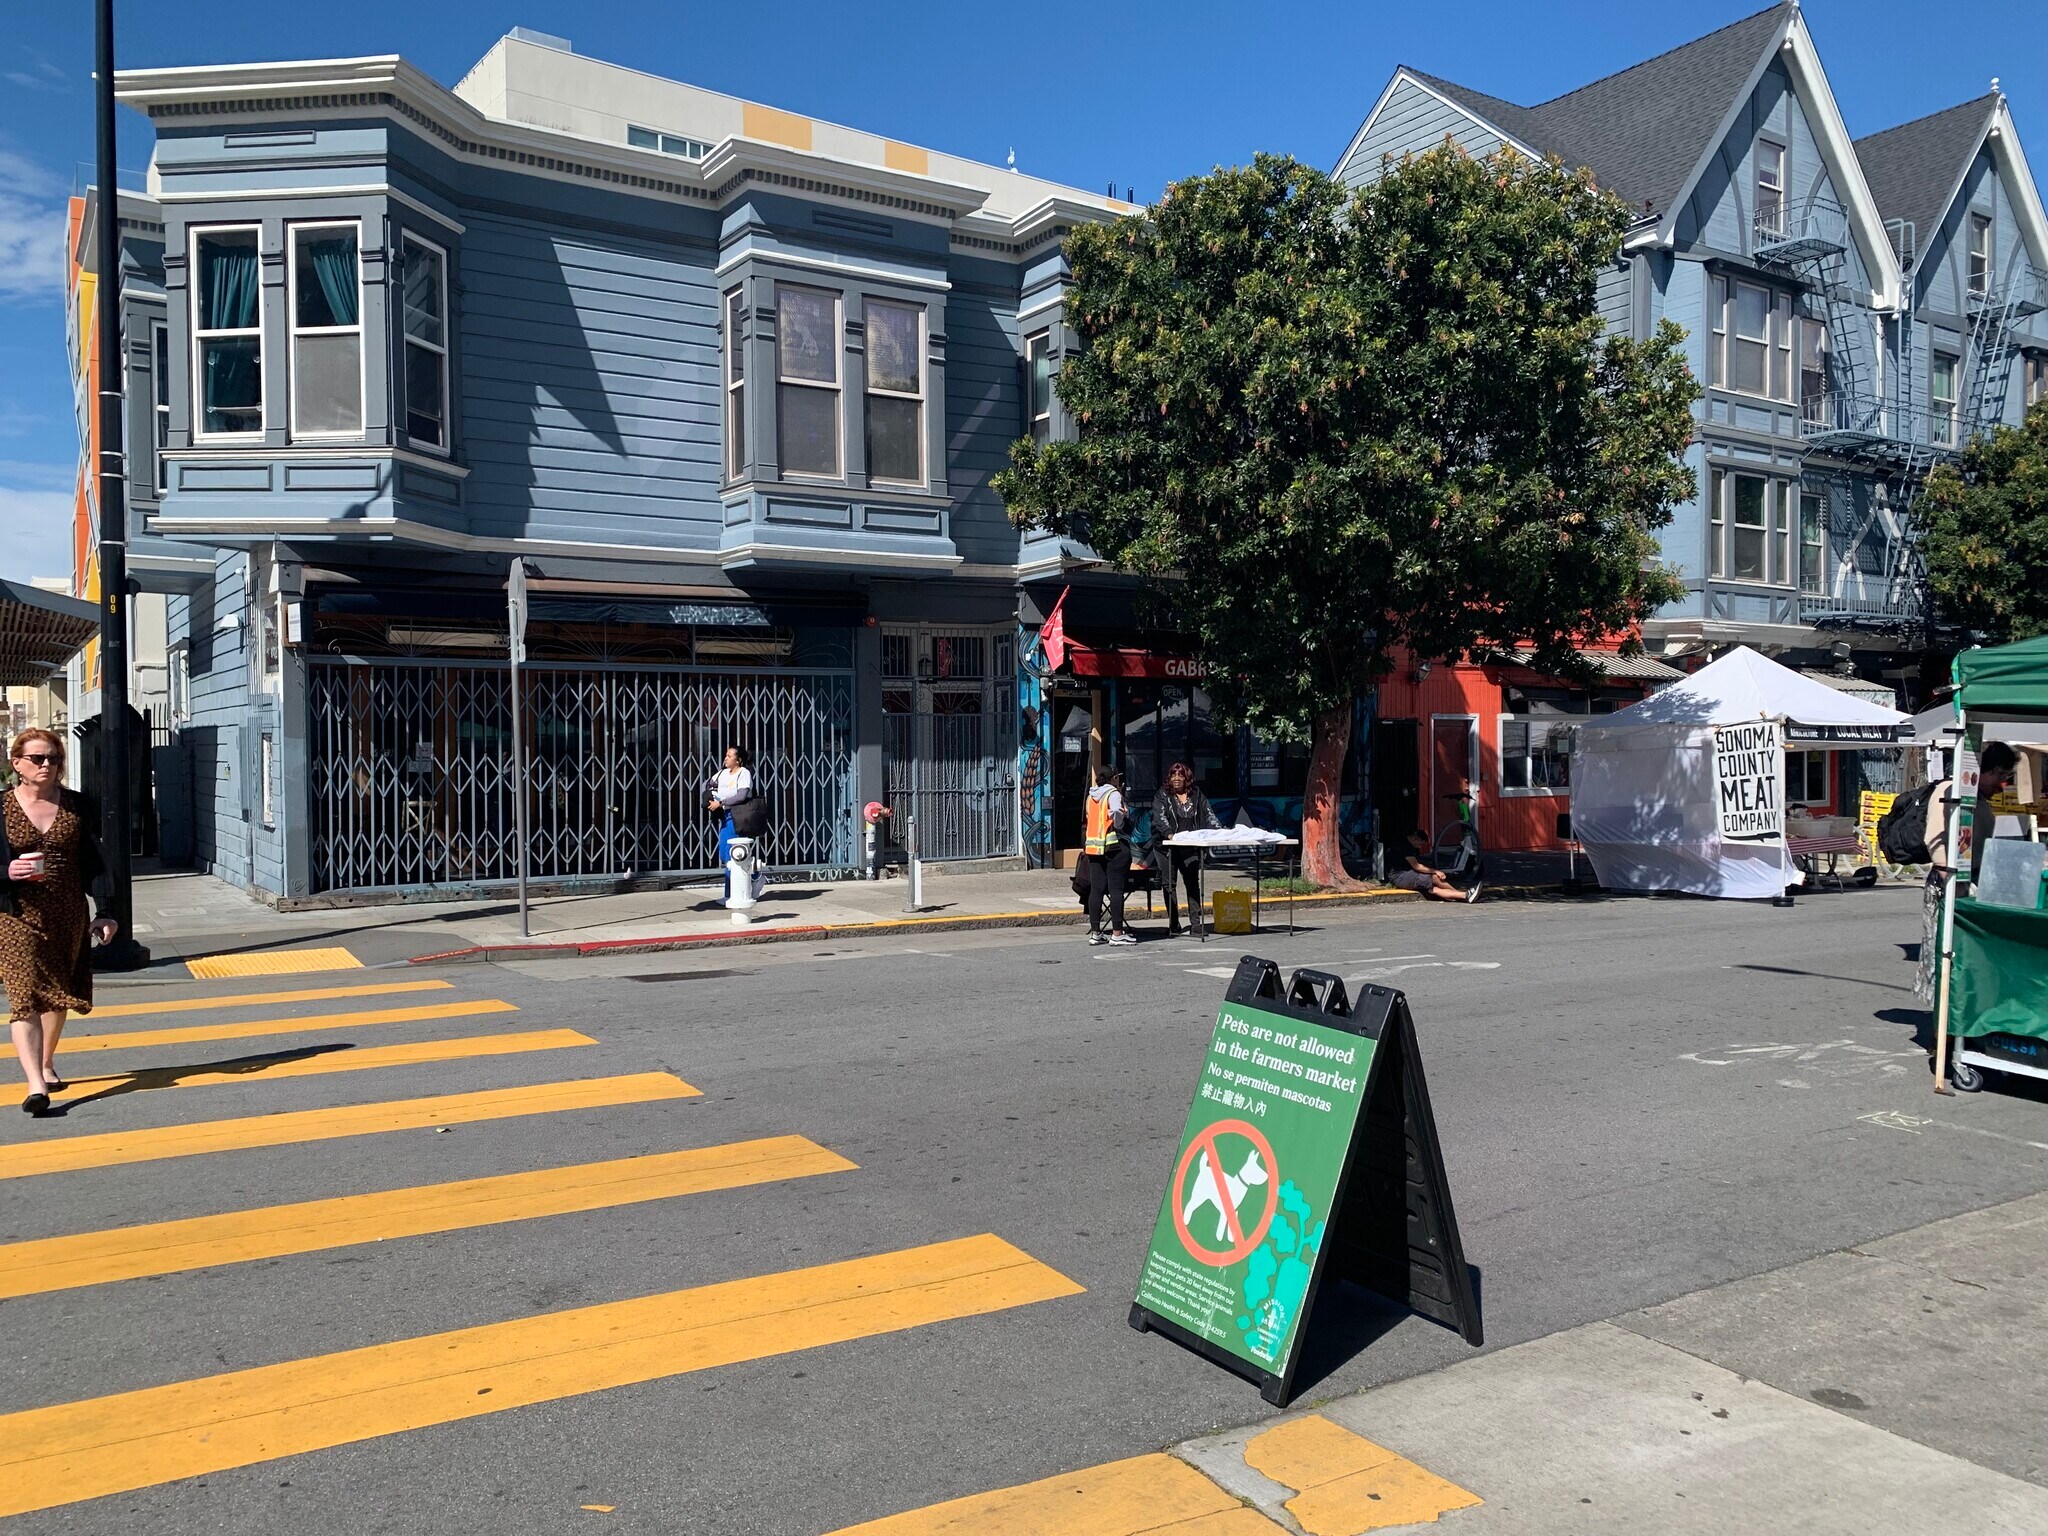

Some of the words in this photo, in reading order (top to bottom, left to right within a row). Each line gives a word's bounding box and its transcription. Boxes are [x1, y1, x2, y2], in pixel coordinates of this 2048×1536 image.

[1164, 659, 1207, 677] GABR
[1163, 686, 1182, 697] OPEN
[1716, 725, 1775, 754] SONOMA
[1718, 750, 1775, 778] COUNTY
[1720, 776, 1775, 812] MEAT
[1723, 812, 1777, 832] COMPANY
[1221, 1014, 1250, 1036] Pets
[1251, 1026, 1272, 1042] are
[1274, 1033, 1298, 1049] not
[1299, 1037, 1355, 1065] allowed
[1214, 1037, 1227, 1054] in
[1230, 1042, 1250, 1061] the
[1251, 1047, 1304, 1077] farmers
[1305, 1068, 1357, 1094] market
[1208, 1062, 1222, 1077] No
[1223, 1069, 1235, 1081] se
[1235, 1073, 1281, 1096] permiten
[1281, 1088, 1332, 1113] mascotas
[1150, 1260, 1166, 1273] keeping
[1166, 1269, 1176, 1277] your
[1176, 1274, 1186, 1282] pets
[1193, 1281, 1202, 1290] feet
[1202, 1287, 1213, 1296] away
[1153, 1251, 1166, 1262] Please
[1166, 1259, 1182, 1271] comply
[1192, 1271, 1203, 1280] state
[1204, 1277, 1228, 1292] regulations
[1229, 1288, 1235, 1296] by
[1162, 1276, 1170, 1284] and
[1170, 1280, 1185, 1291] vendor
[1141, 1290, 1161, 1305] California
[1161, 1300, 1176, 1312] Health
[1179, 1310, 1193, 1322] Safety
[1194, 1317, 1205, 1328] Code
[1152, 1281, 1166, 1292] always
[1187, 1298, 1200, 1309] Thank
[1263, 1299, 1285, 1319] MISSION
